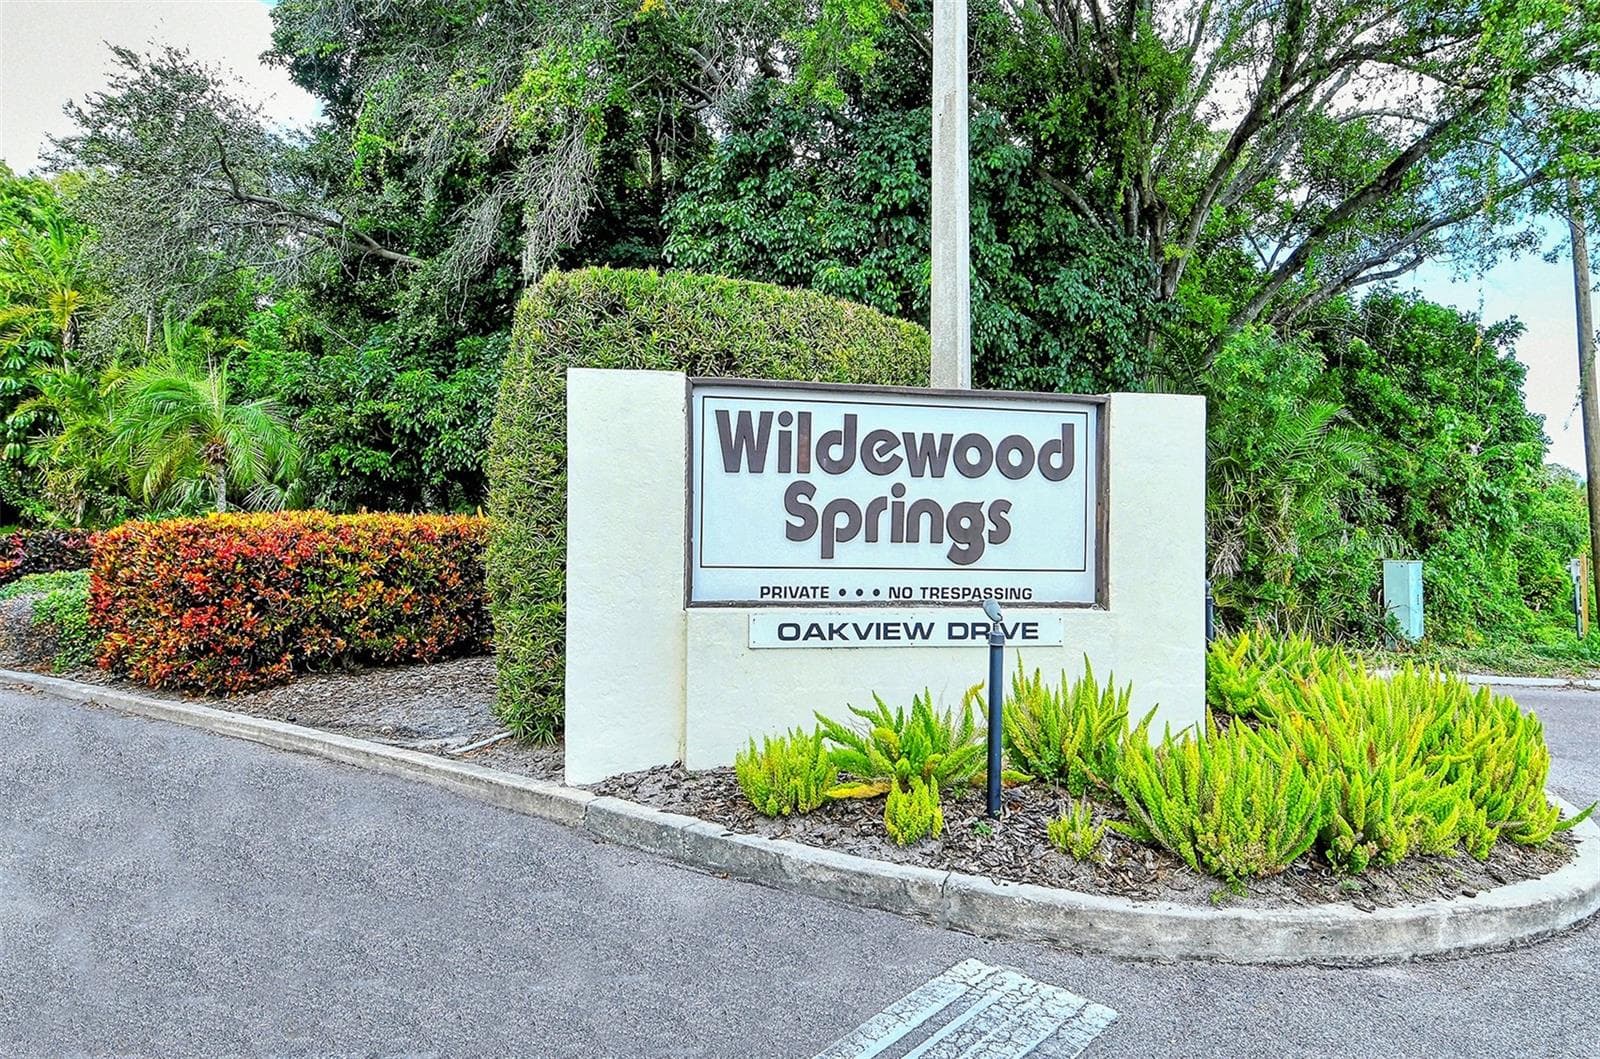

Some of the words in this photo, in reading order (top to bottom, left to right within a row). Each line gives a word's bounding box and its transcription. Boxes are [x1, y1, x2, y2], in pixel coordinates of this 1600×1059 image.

[715, 409, 1075, 482] Wildewood
[784, 480, 1013, 566] Springs
[760, 586, 830, 599] PRIVATE
[888, 587, 913, 599] NO
[920, 587, 1033, 600] TRESPASSING
[777, 622, 935, 641] OAKVIEW
